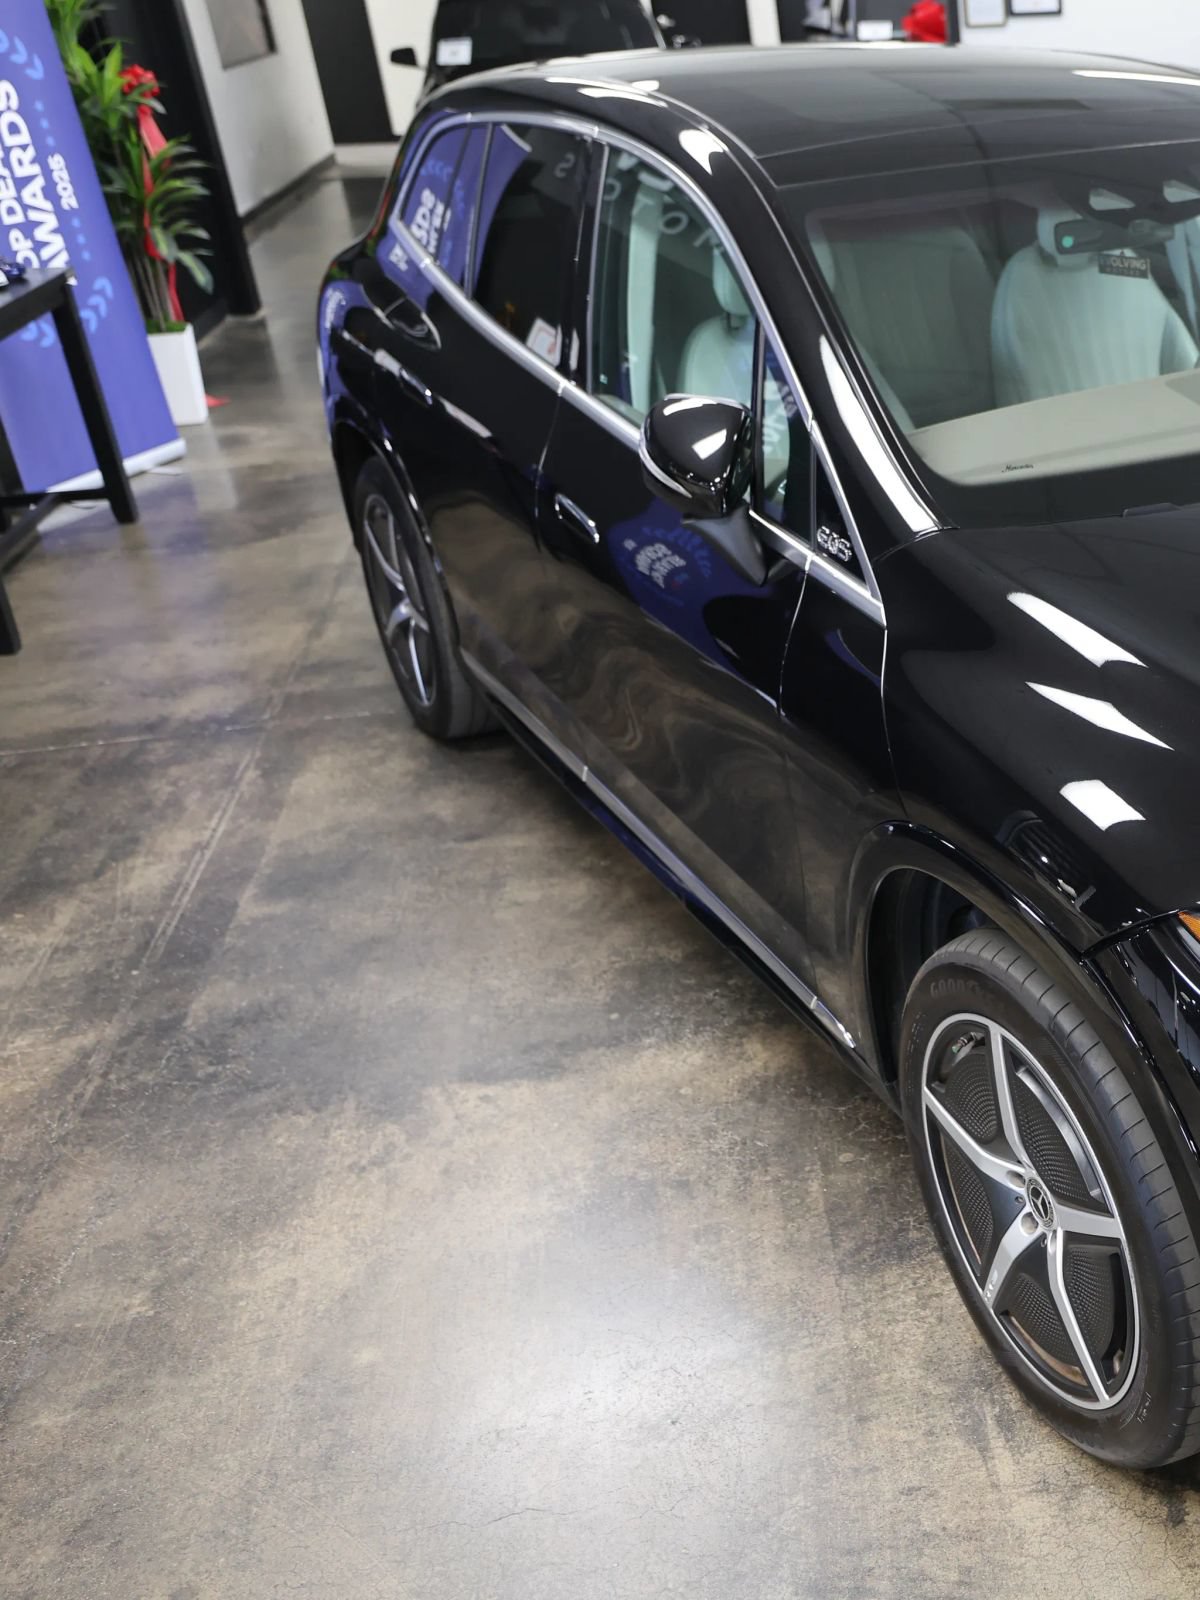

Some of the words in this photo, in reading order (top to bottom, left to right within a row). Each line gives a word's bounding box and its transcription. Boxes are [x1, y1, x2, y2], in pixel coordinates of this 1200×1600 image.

[0, 146, 26, 225] DE
[47, 153, 79, 211] 2025
[9, 228, 40, 268] OP
